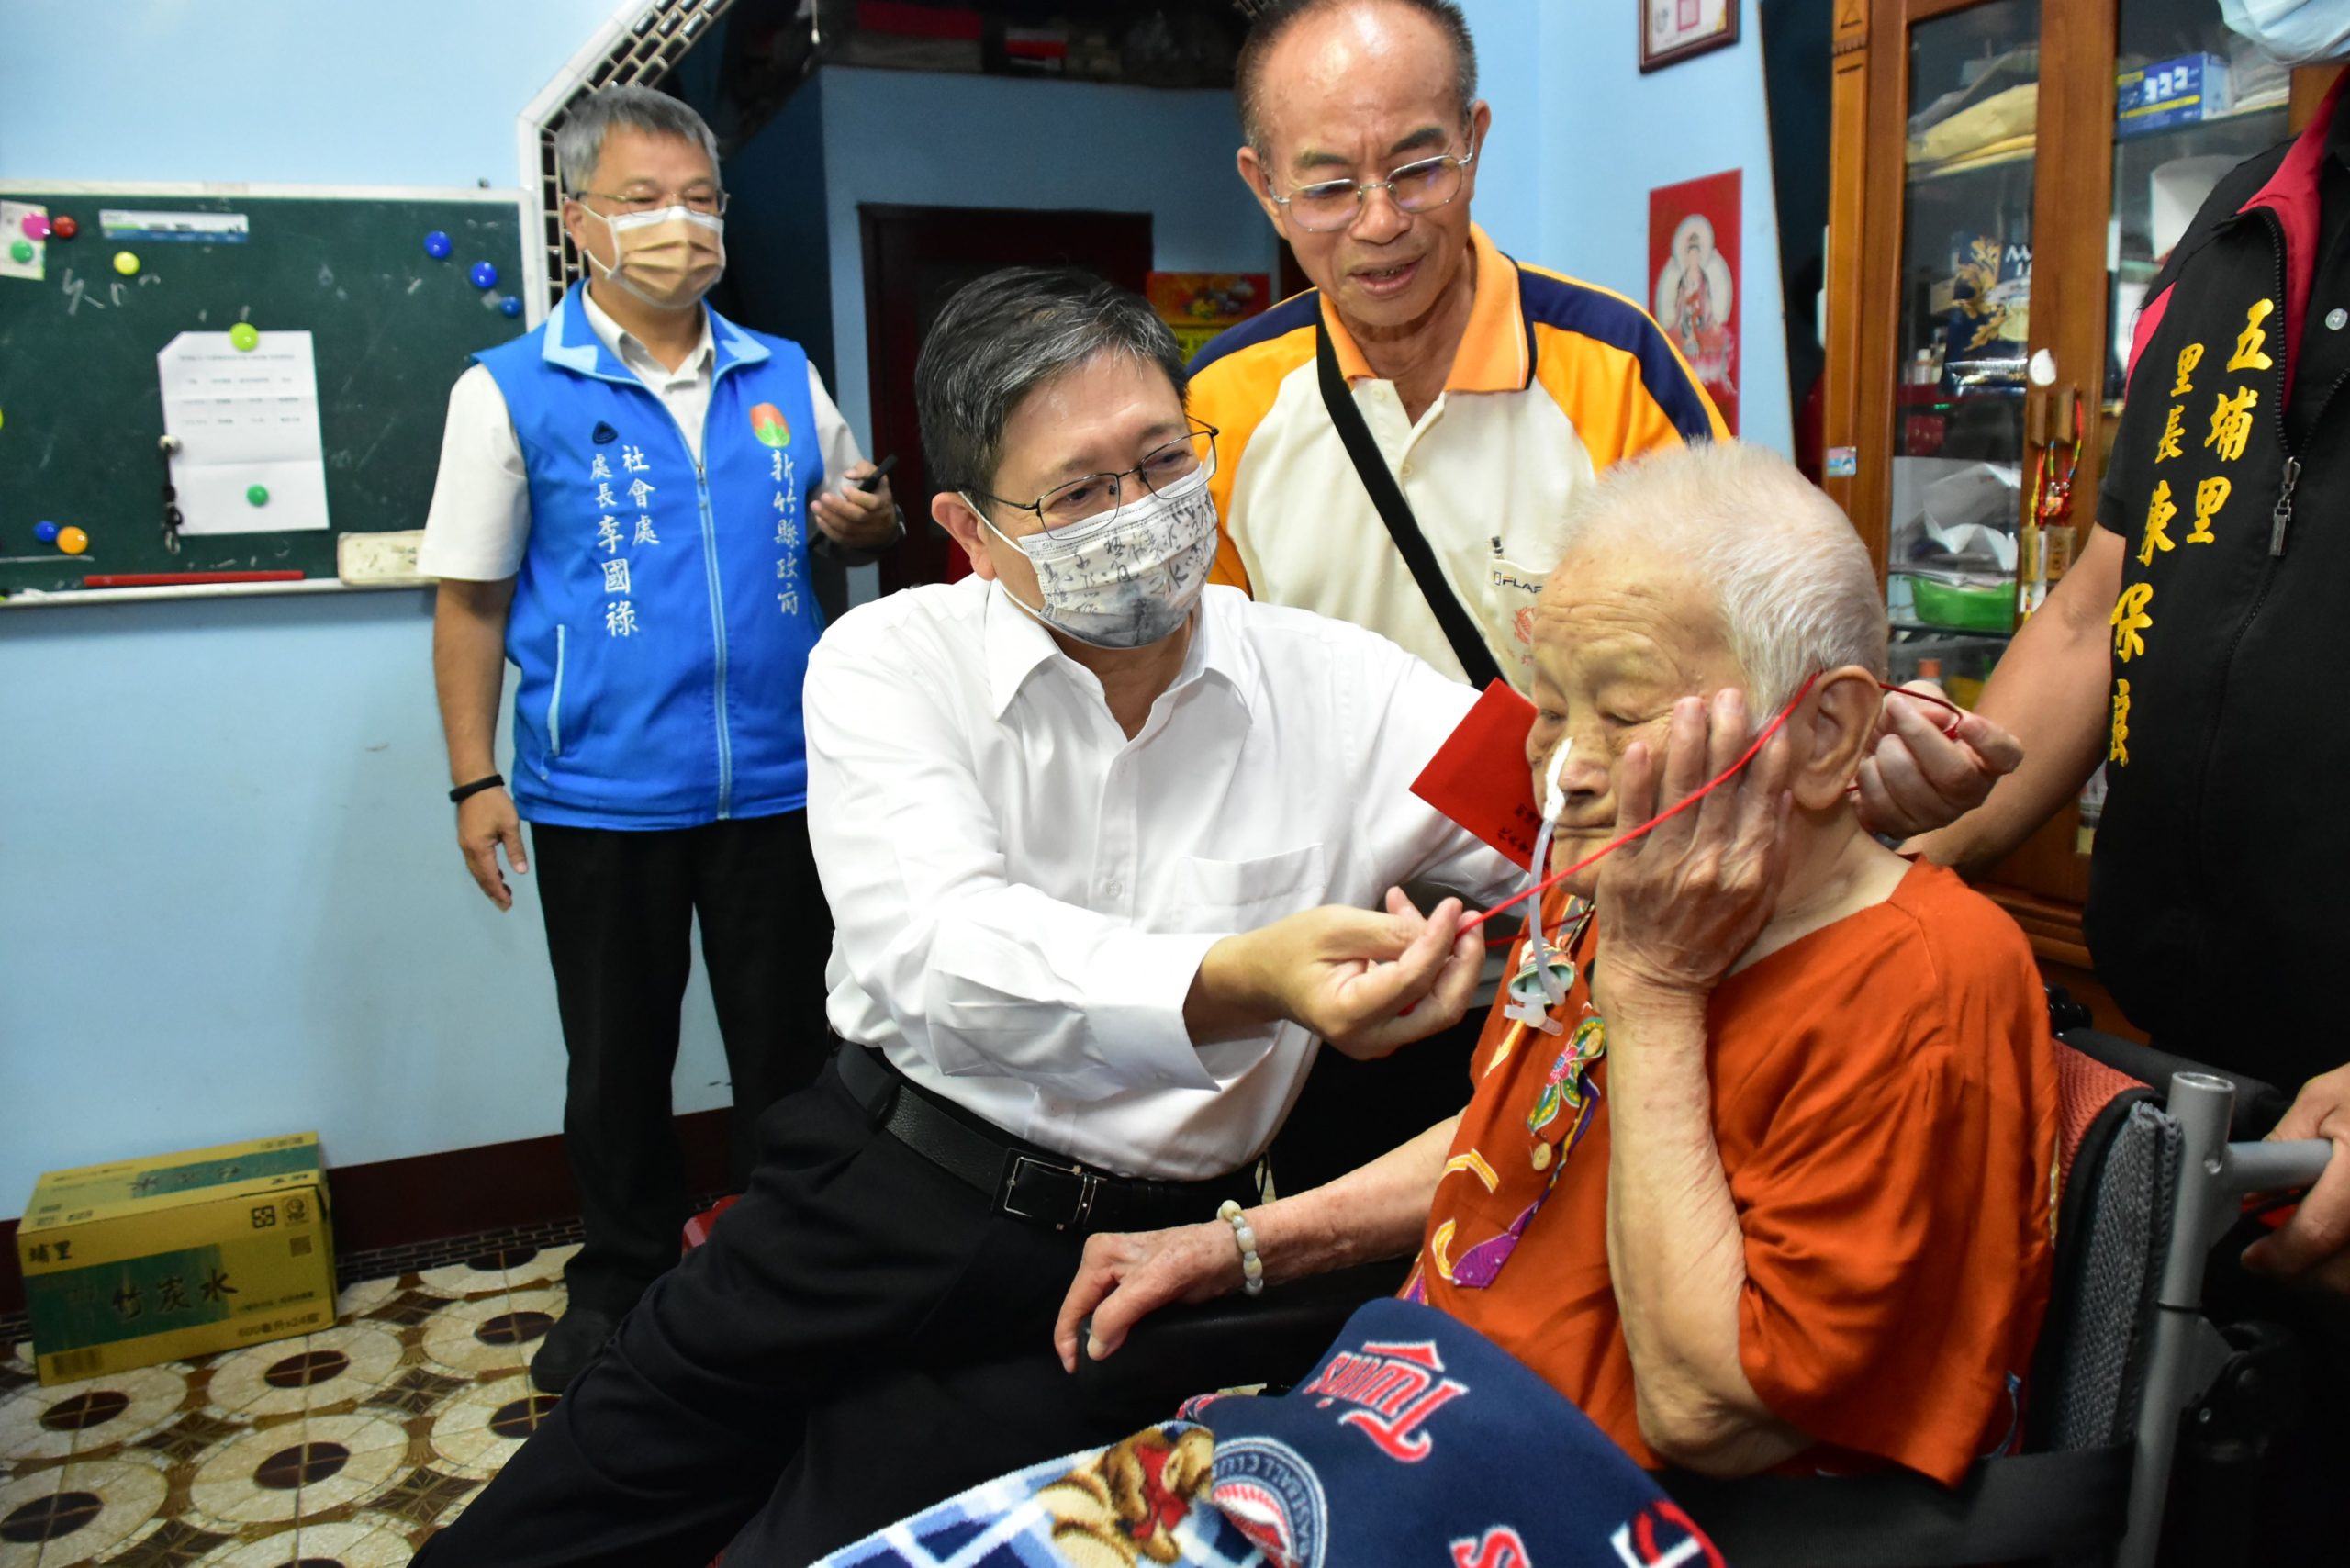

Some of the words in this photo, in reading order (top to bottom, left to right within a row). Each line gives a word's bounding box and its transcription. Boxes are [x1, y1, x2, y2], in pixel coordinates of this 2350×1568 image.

[621, 445, 661, 546] 社會處
[2186, 297, 2274, 544] 五埔里
[590, 453, 640, 638] 處長李國祿
[770, 449, 800, 616] 新竹縣政府
[111, 1268, 239, 1321] 竹炭水
